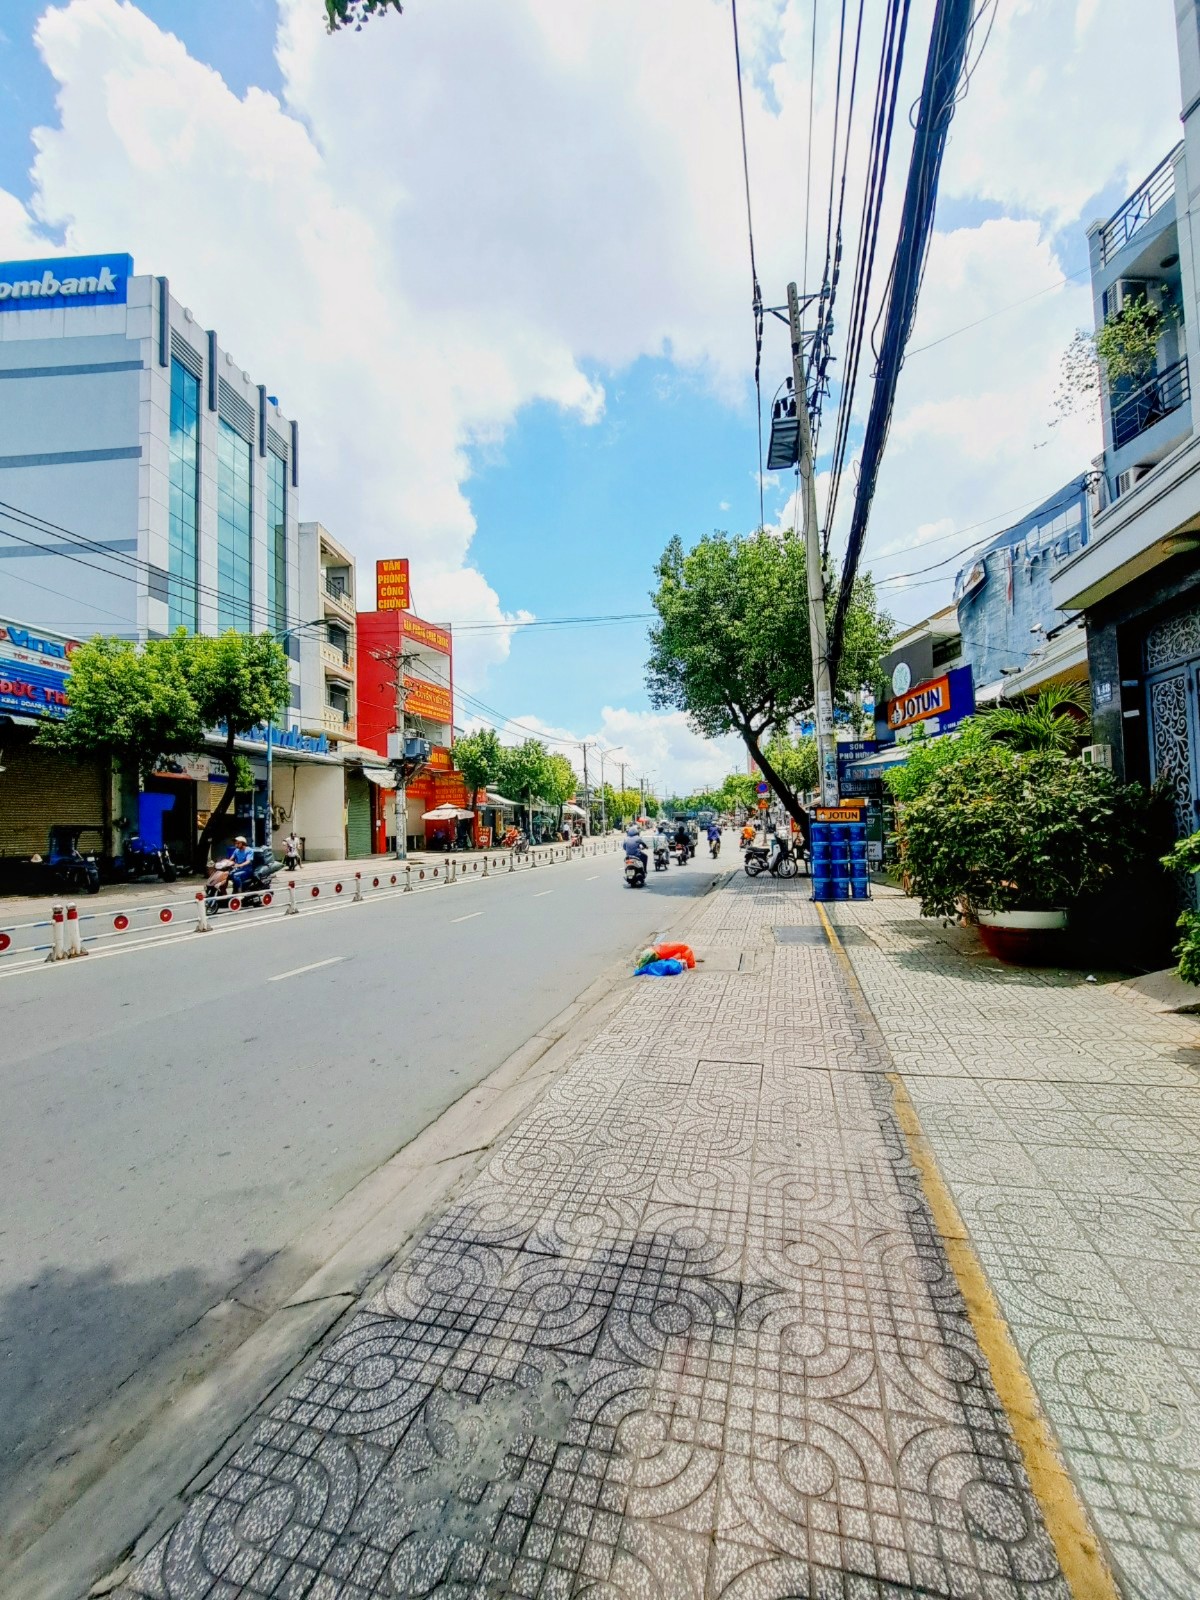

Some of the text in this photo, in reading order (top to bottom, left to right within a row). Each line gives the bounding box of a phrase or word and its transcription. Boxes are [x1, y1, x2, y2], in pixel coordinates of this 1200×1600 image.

[378, 573, 406, 584] PHÒNG
[381, 586, 404, 596] CÔNG
[378, 597, 407, 608] CHỨNG
[903, 687, 943, 720] JOTUN
[828, 811, 858, 820] JOTUN
